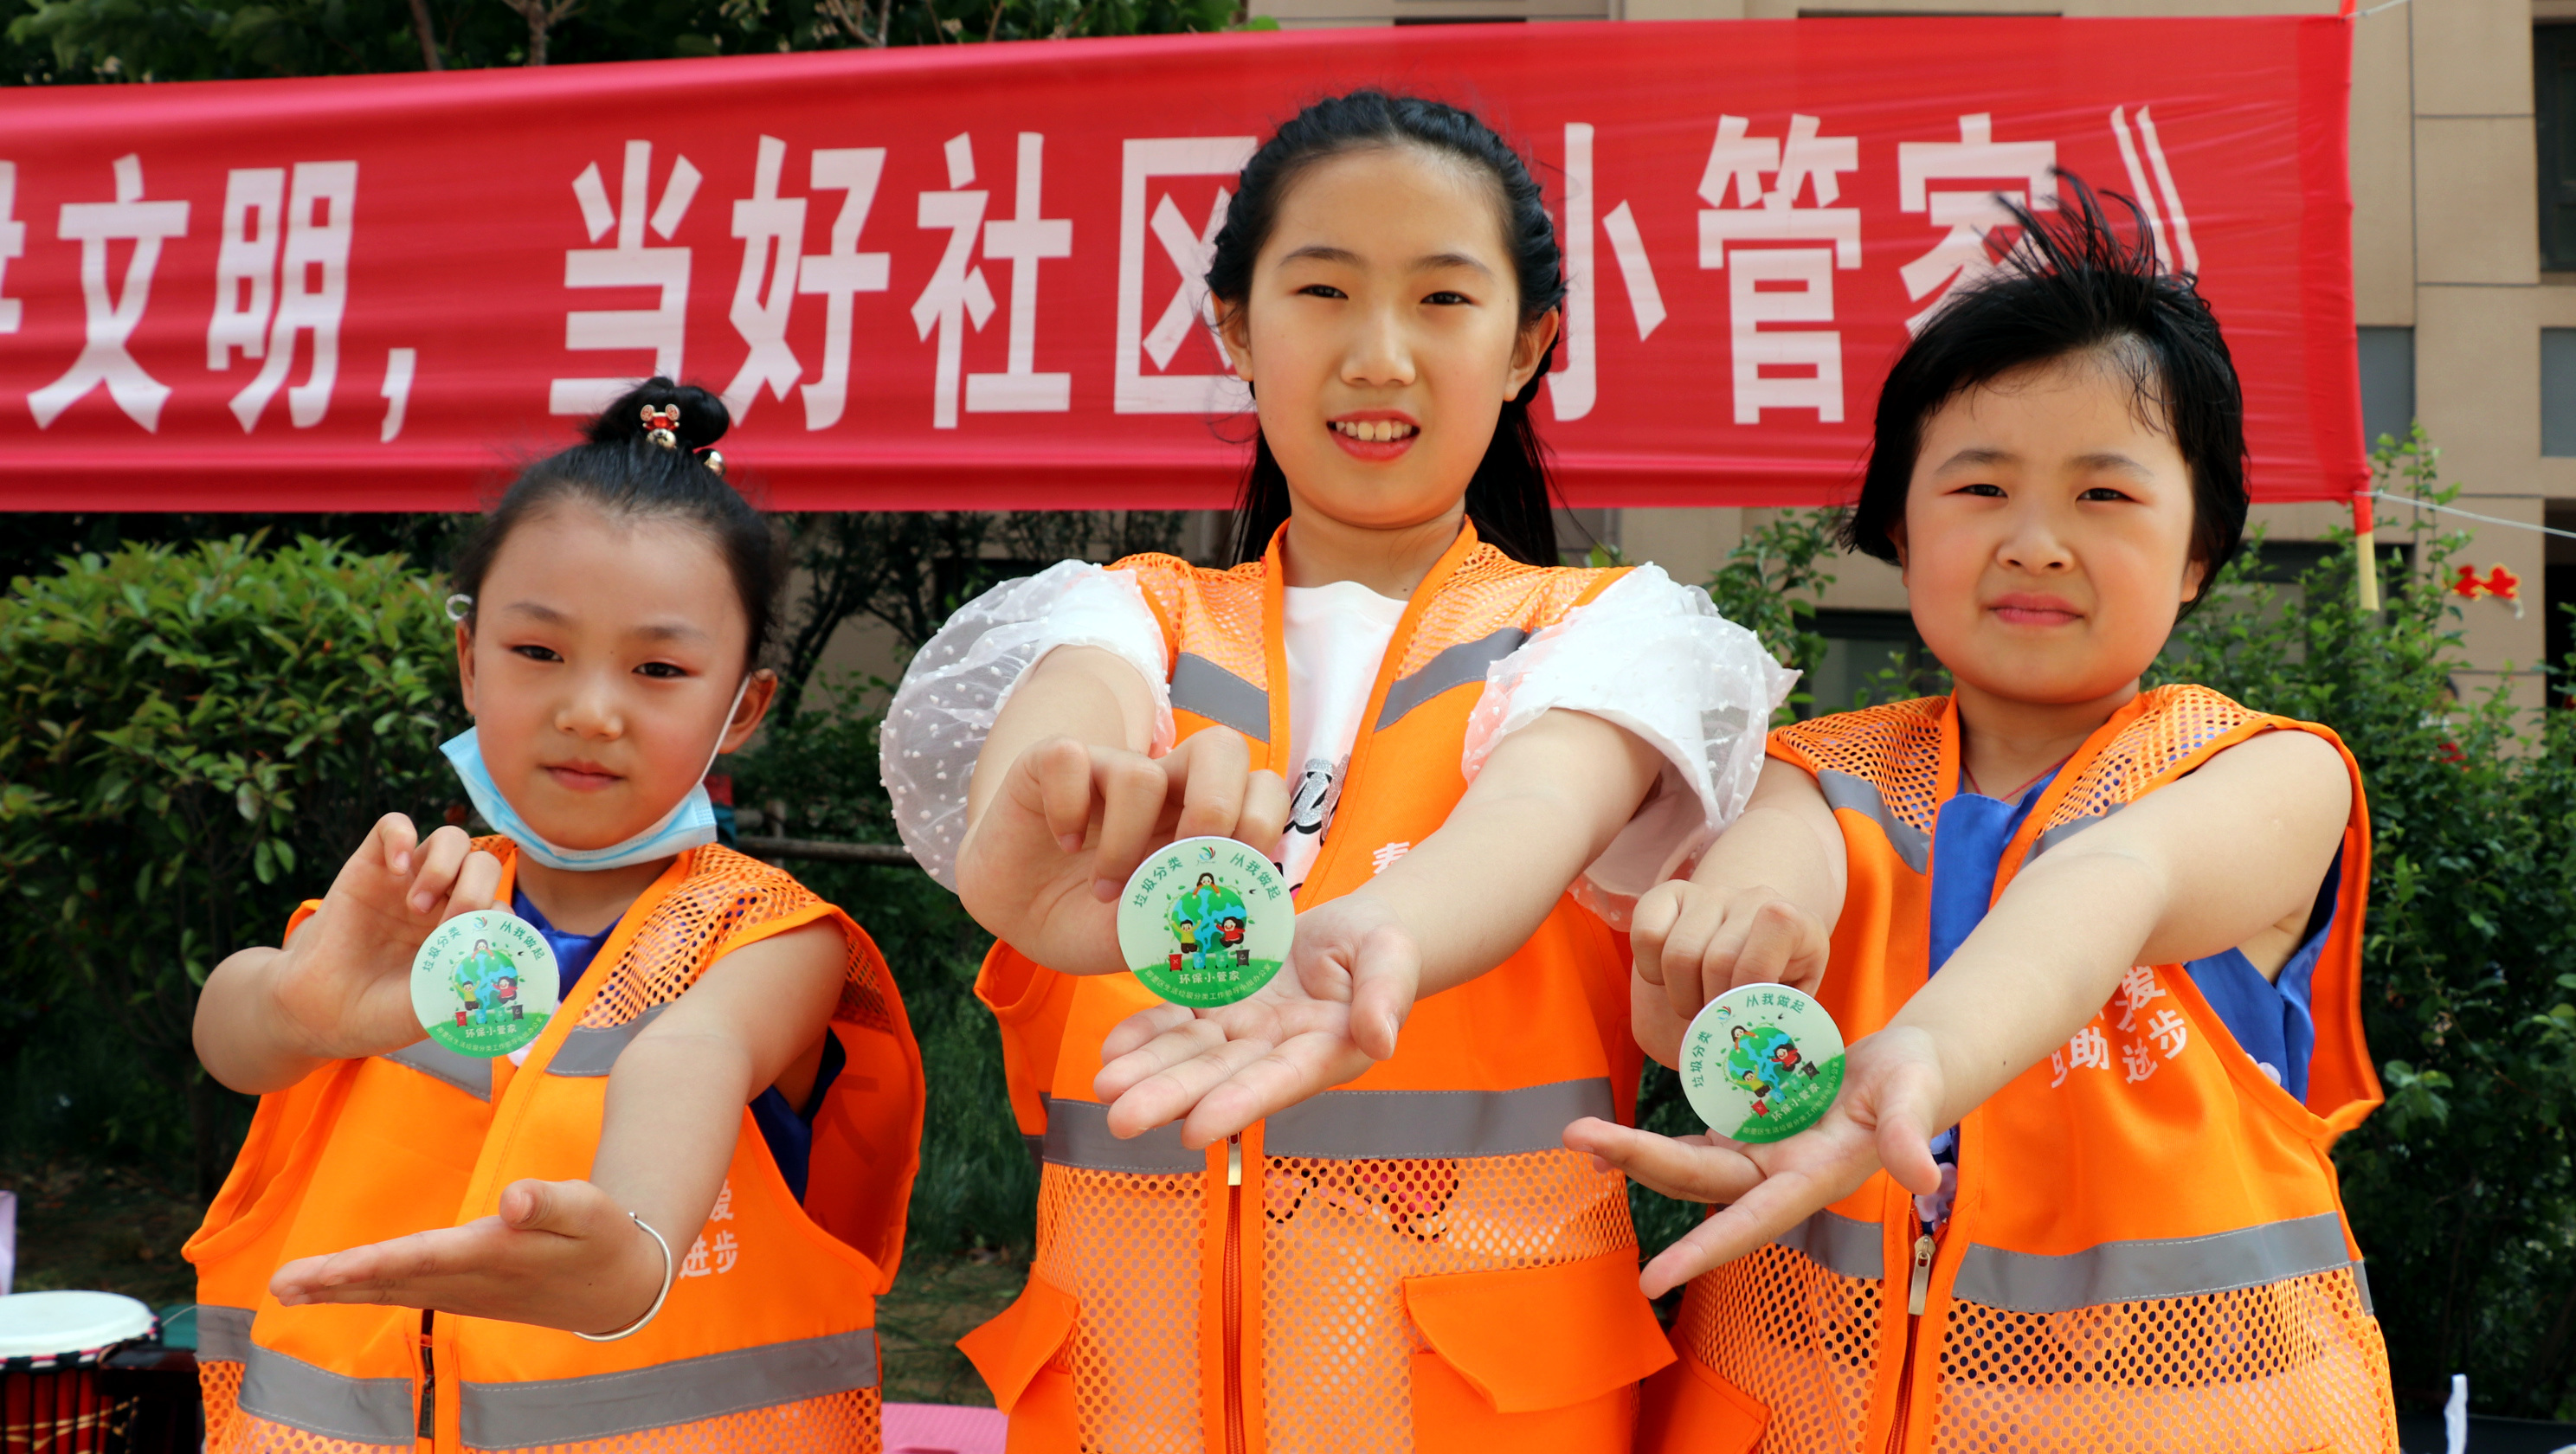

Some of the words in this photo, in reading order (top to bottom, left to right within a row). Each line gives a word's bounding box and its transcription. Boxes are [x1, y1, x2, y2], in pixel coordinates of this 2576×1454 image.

[1133, 855, 1183, 908] 垃圾分类
[1229, 852, 1281, 901] 从我做起
[422, 925, 462, 973] 垃圾分类
[499, 920, 545, 962] 从我做起
[1179, 970, 1240, 985] 环保小管家
[465, 1023, 518, 1039] 环保小管家
[1690, 1030, 1713, 1089] 垃圾分类
[1746, 993, 1806, 1014] 从我做起
[1771, 1082, 1821, 1123] 环保小管家
